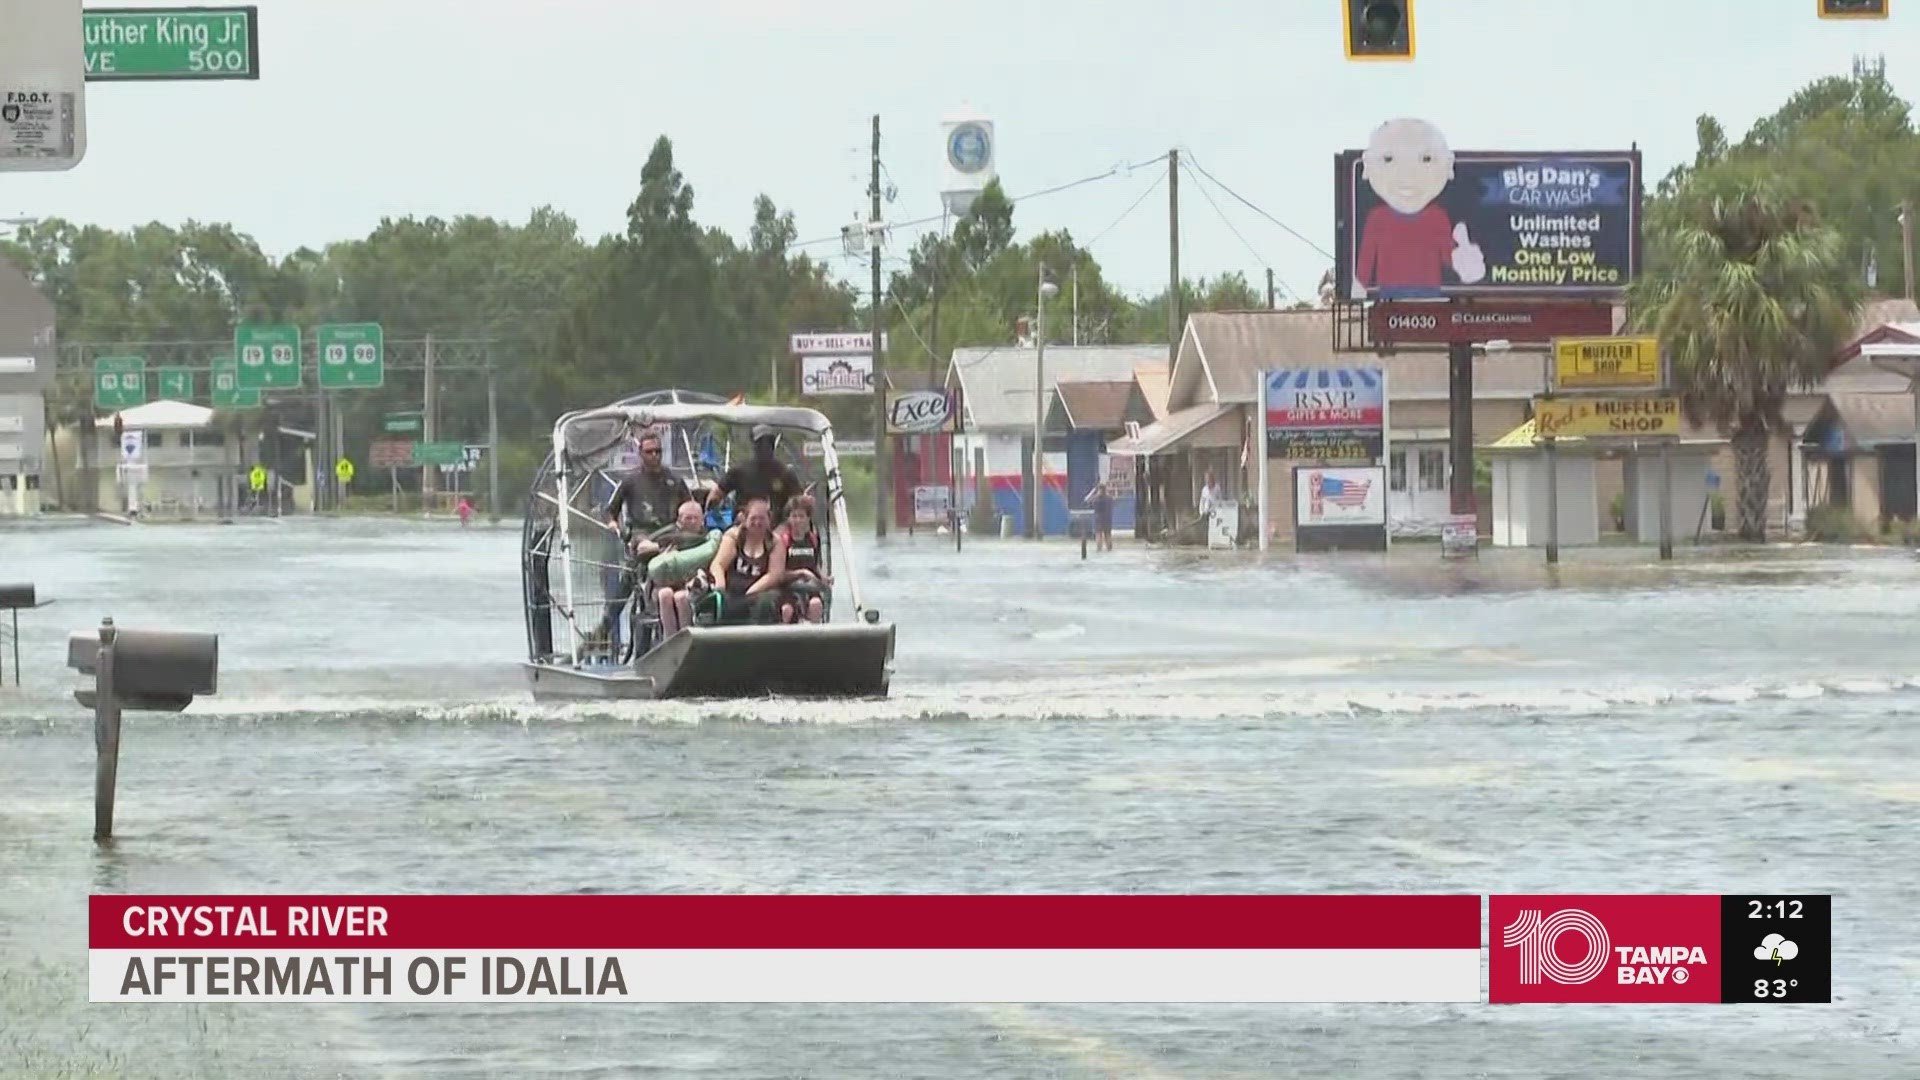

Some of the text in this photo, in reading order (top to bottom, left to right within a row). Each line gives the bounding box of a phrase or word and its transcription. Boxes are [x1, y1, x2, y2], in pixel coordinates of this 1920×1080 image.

[85, 17, 241, 51] uther King Jr
[83, 51, 242, 72] VE 500
[8, 92, 52, 103] F.D.O.T.
[1503, 167, 1600, 190] Big Dan's
[1509, 188, 1593, 206] CAR WASH
[1510, 215, 1600, 231] Unlimited
[1519, 232, 1591, 248] Washes
[1515, 250, 1595, 265] One Low
[1492, 265, 1618, 285] Monthly Price
[1389, 315, 1436, 329] 014030
[797, 337, 873, 349] BUY SELL TRA
[246, 347, 291, 361] 19 98
[329, 347, 373, 361] 19 98
[1582, 345, 1632, 359] MUFFLER
[1593, 360, 1622, 372] SHOP
[1295, 391, 1355, 408] RSVP
[892, 396, 949, 426] Excel
[1287, 409, 1362, 420] GIFTS & MORE
[1595, 401, 1675, 416] MUFFLER
[1609, 417, 1663, 431] SHOP
